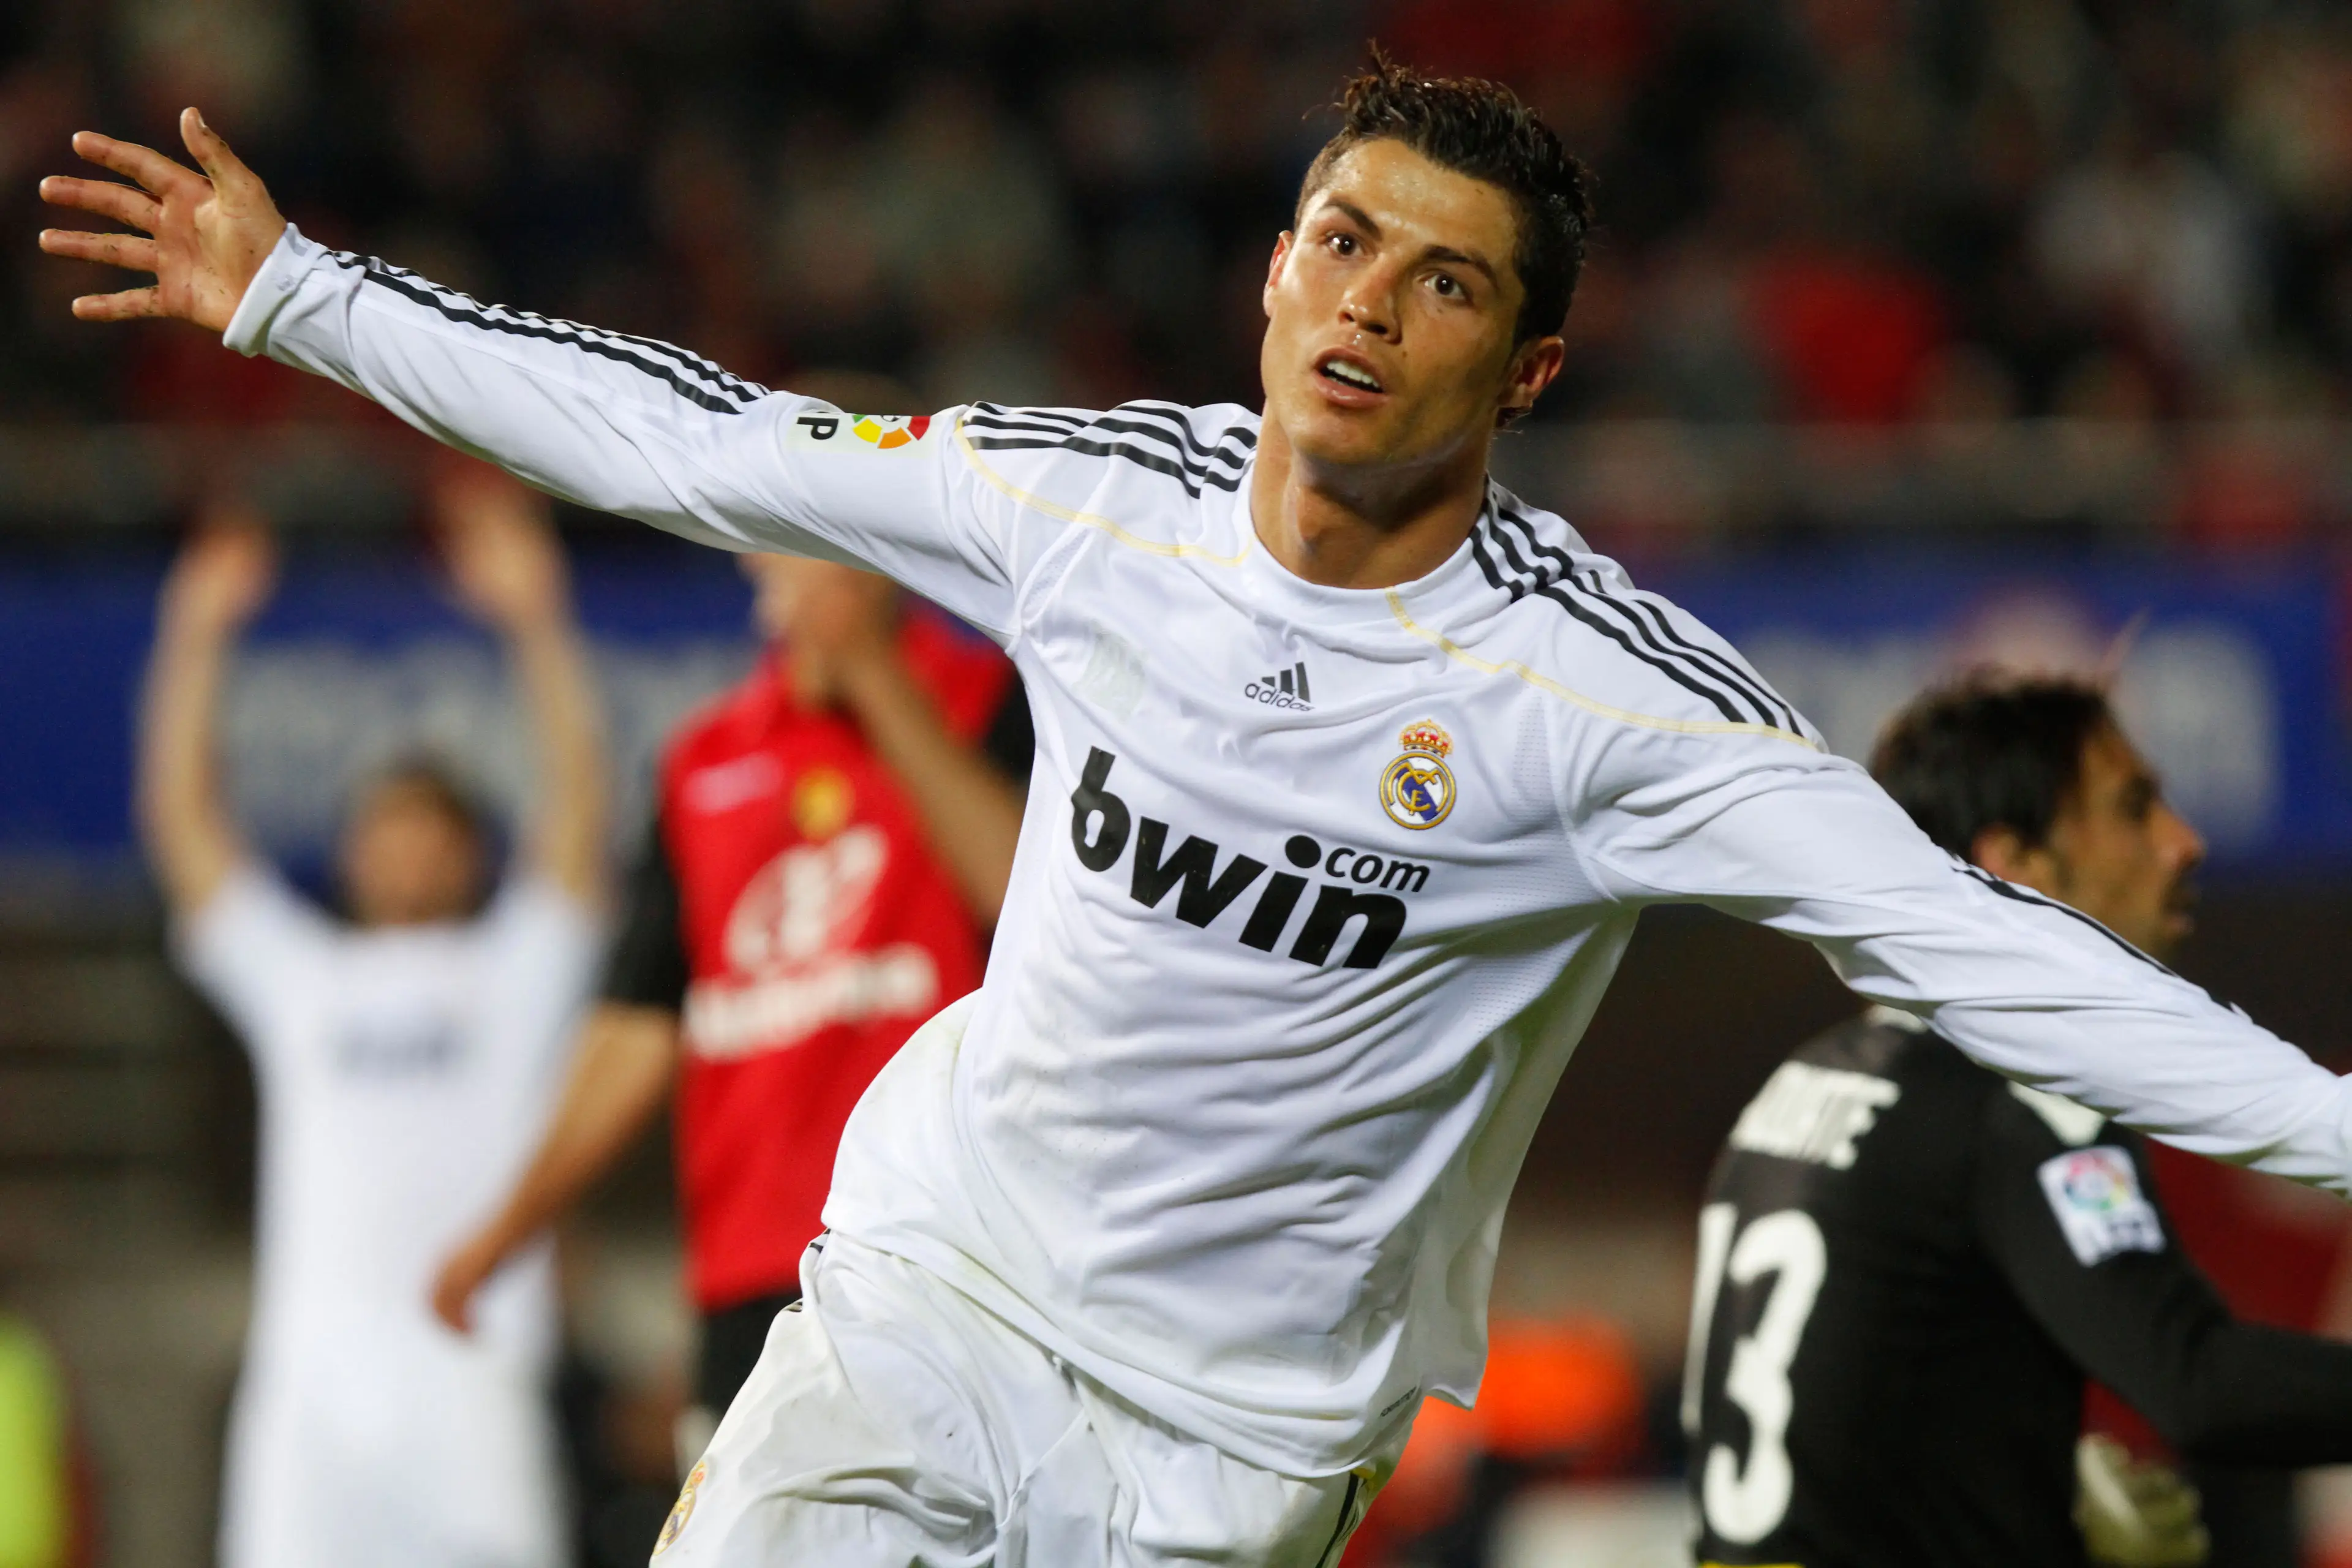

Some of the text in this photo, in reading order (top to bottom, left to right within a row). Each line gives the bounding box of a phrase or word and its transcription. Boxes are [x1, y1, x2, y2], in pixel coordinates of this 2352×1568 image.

[797, 411, 839, 440] P
[1245, 682, 1315, 711] adidas
[1071, 745, 1406, 969] bwin
[1680, 1202, 1827, 1545] 13
